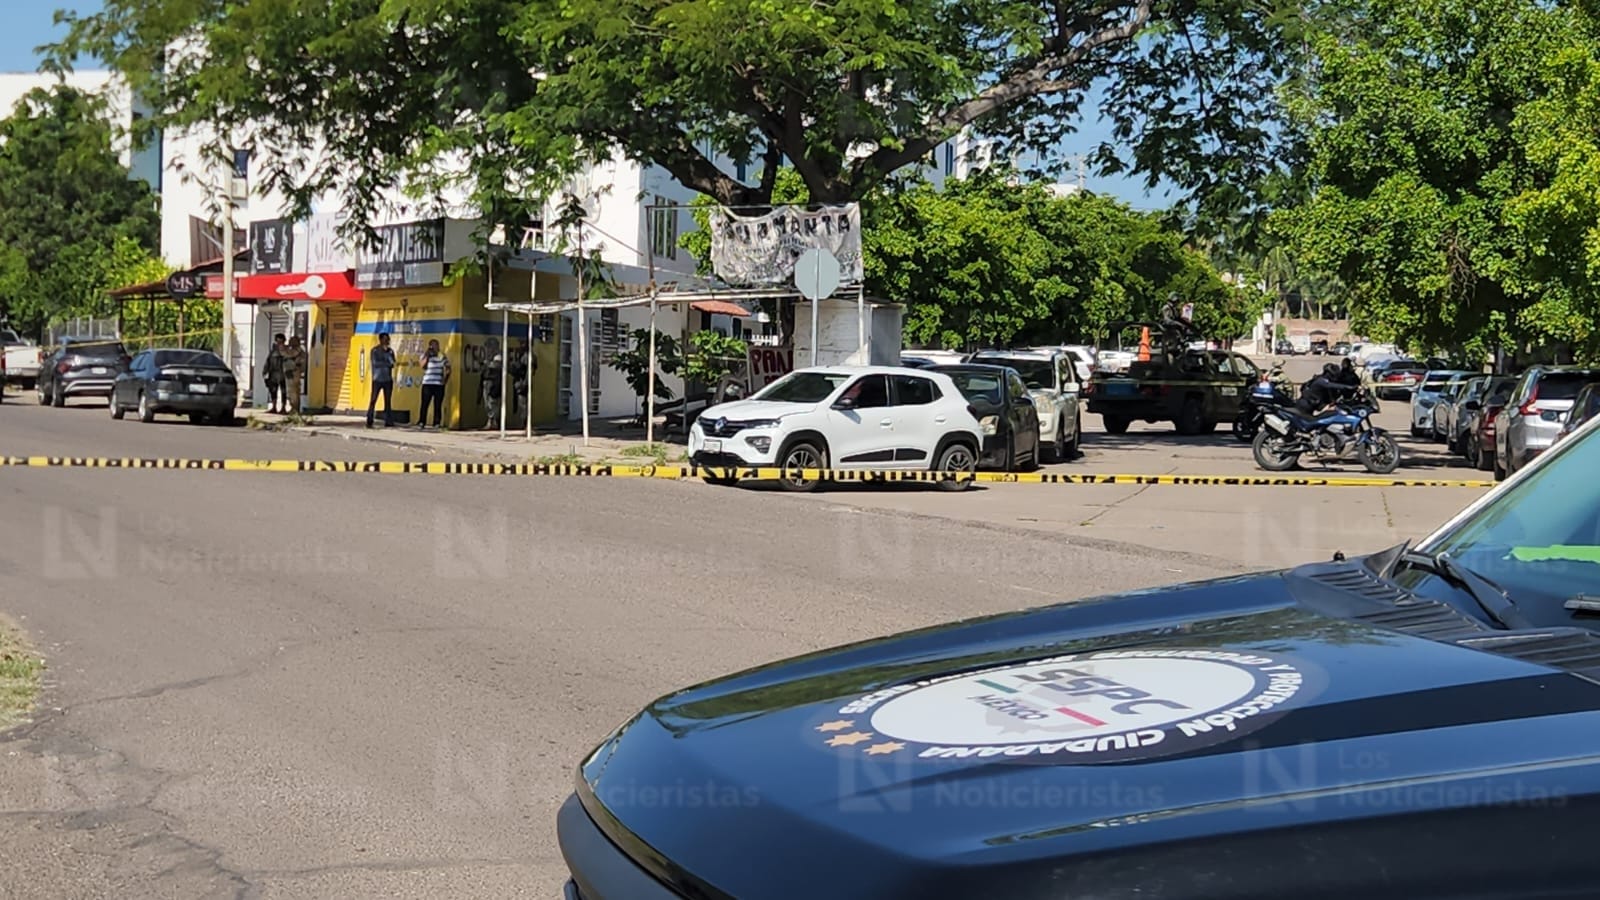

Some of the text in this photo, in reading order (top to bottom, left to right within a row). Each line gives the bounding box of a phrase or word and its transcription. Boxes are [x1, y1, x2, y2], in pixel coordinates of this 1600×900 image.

[1013, 668, 1193, 715] SSPC
[1176, 671, 1303, 737] PROTECCIÓN
[918, 729, 1165, 758] CIUDADANA
